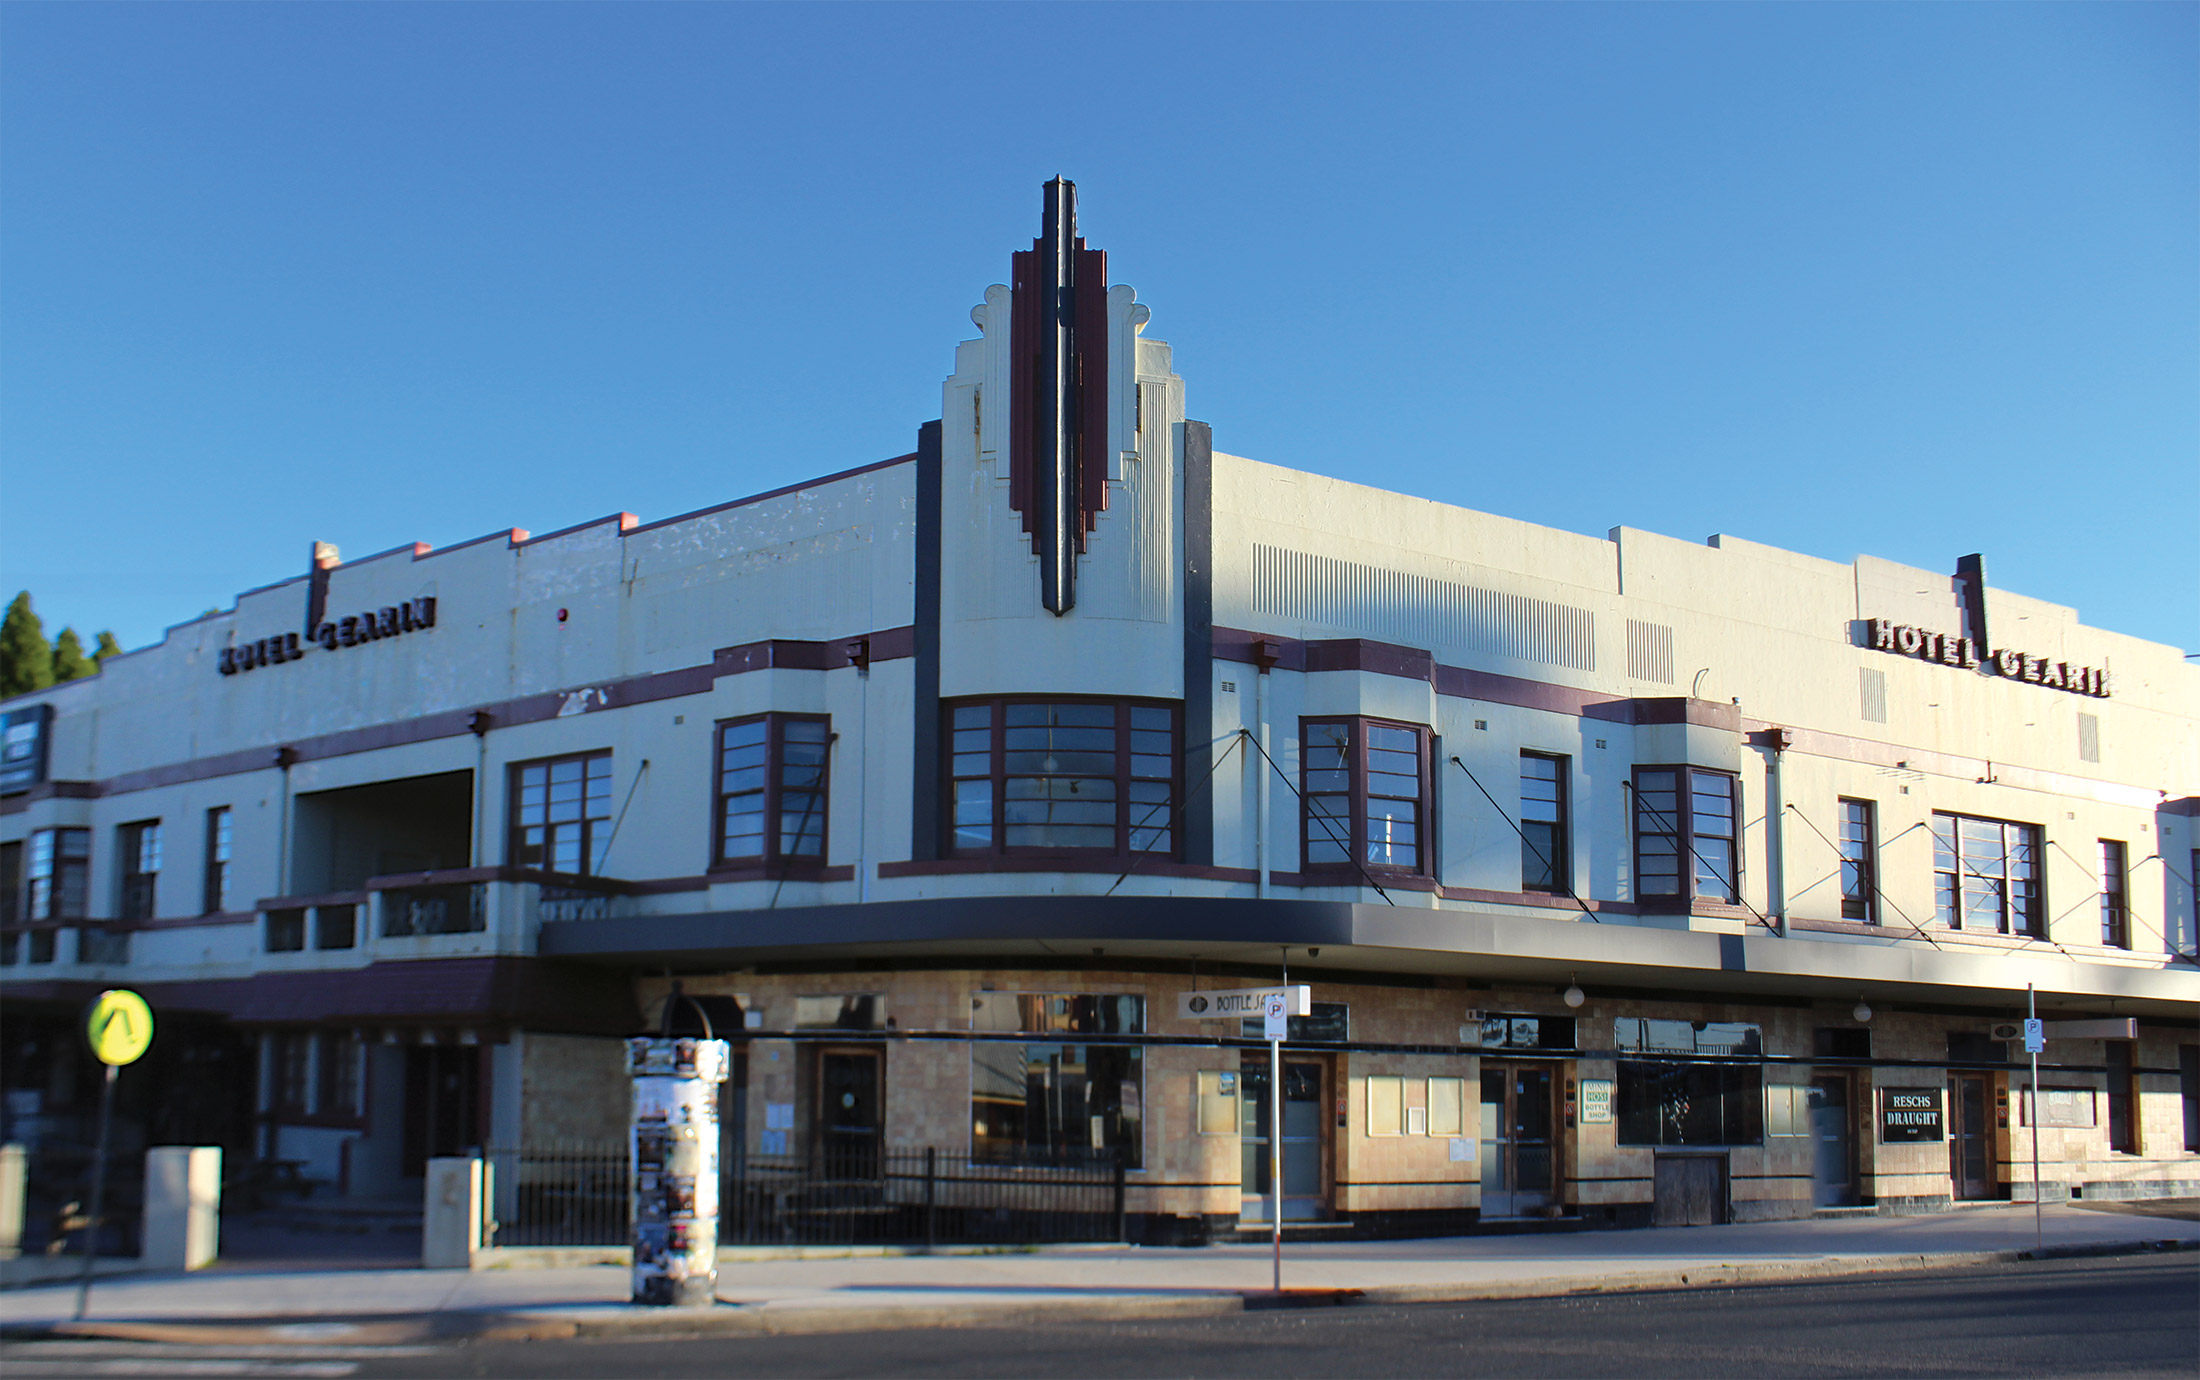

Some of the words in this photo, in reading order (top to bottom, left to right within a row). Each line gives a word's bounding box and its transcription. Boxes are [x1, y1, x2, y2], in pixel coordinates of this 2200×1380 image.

[1875, 617, 1981, 669] HOTEL
[1216, 994, 1252, 1012] BOTTLE
[1585, 1103, 1609, 1111] BOTTLE
[1893, 1095, 1931, 1108] RESCHS
[1887, 1111, 1938, 1126] DRAUGHT
